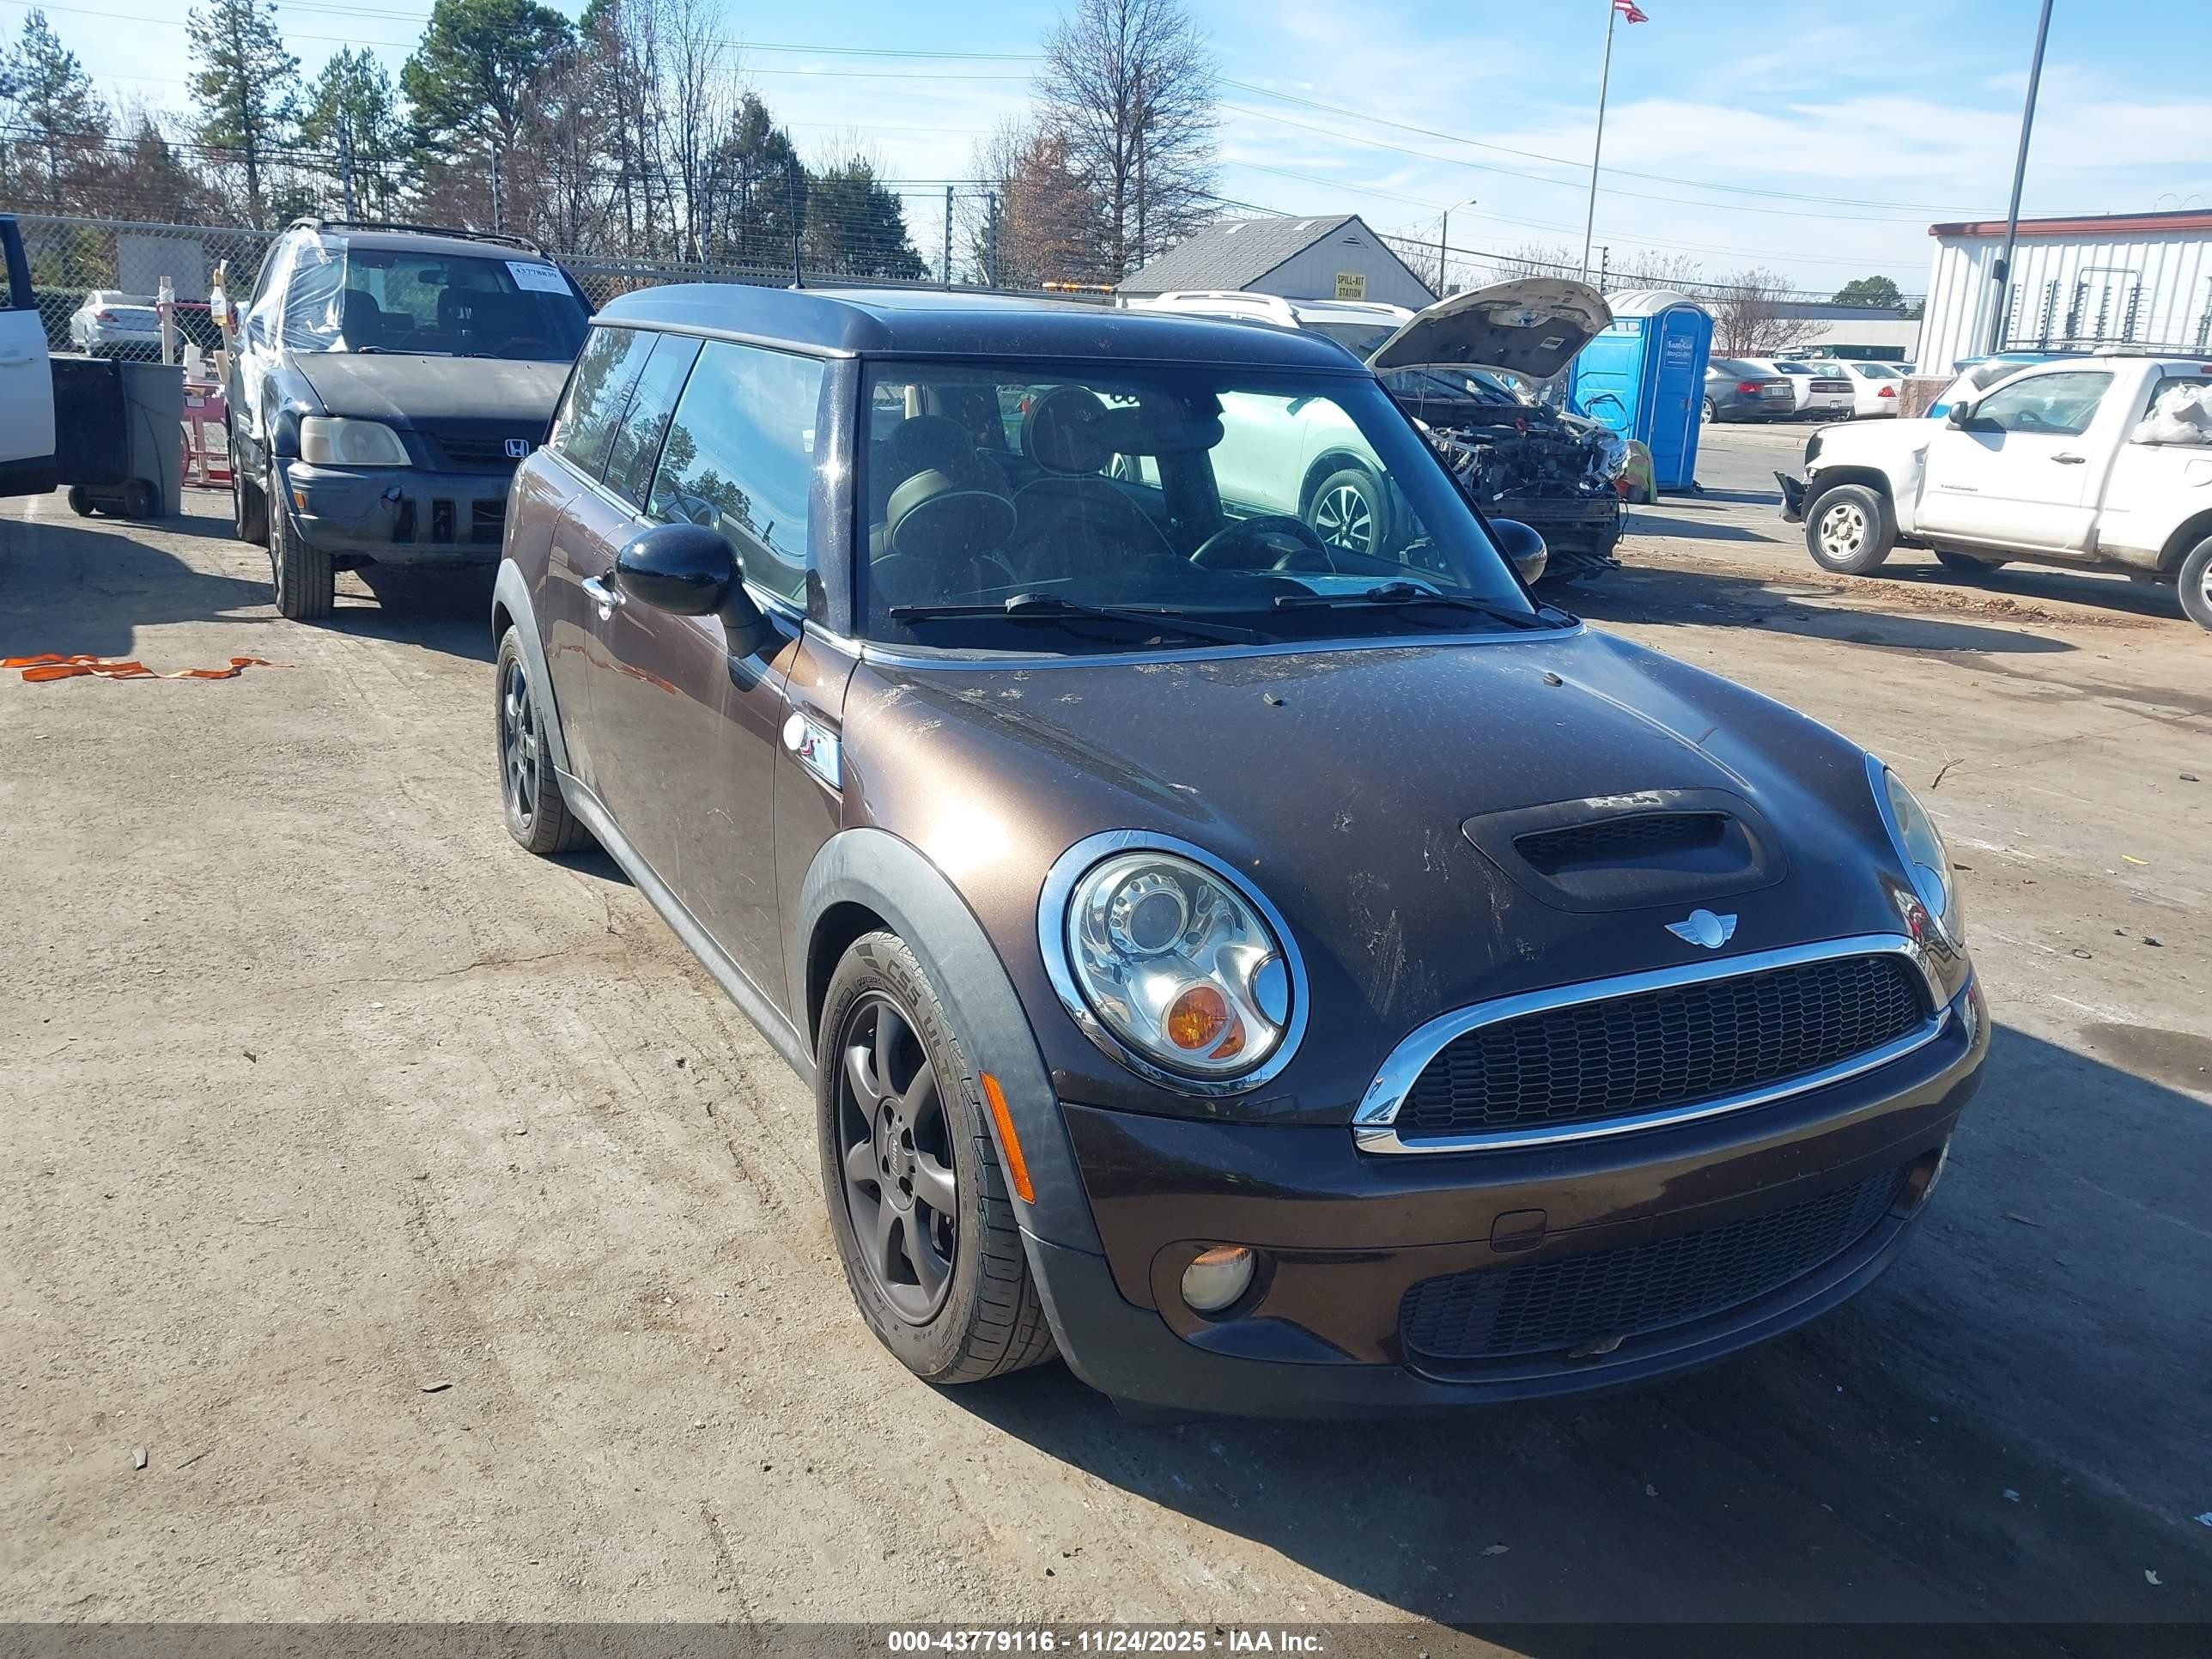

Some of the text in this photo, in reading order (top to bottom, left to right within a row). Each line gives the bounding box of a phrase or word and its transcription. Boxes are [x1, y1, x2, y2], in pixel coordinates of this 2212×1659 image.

[1337, 274, 1364, 286] SPILL-KIT
[1338, 287, 1362, 298] STATION
[886, 958, 959, 1109] CS5 ULTR
